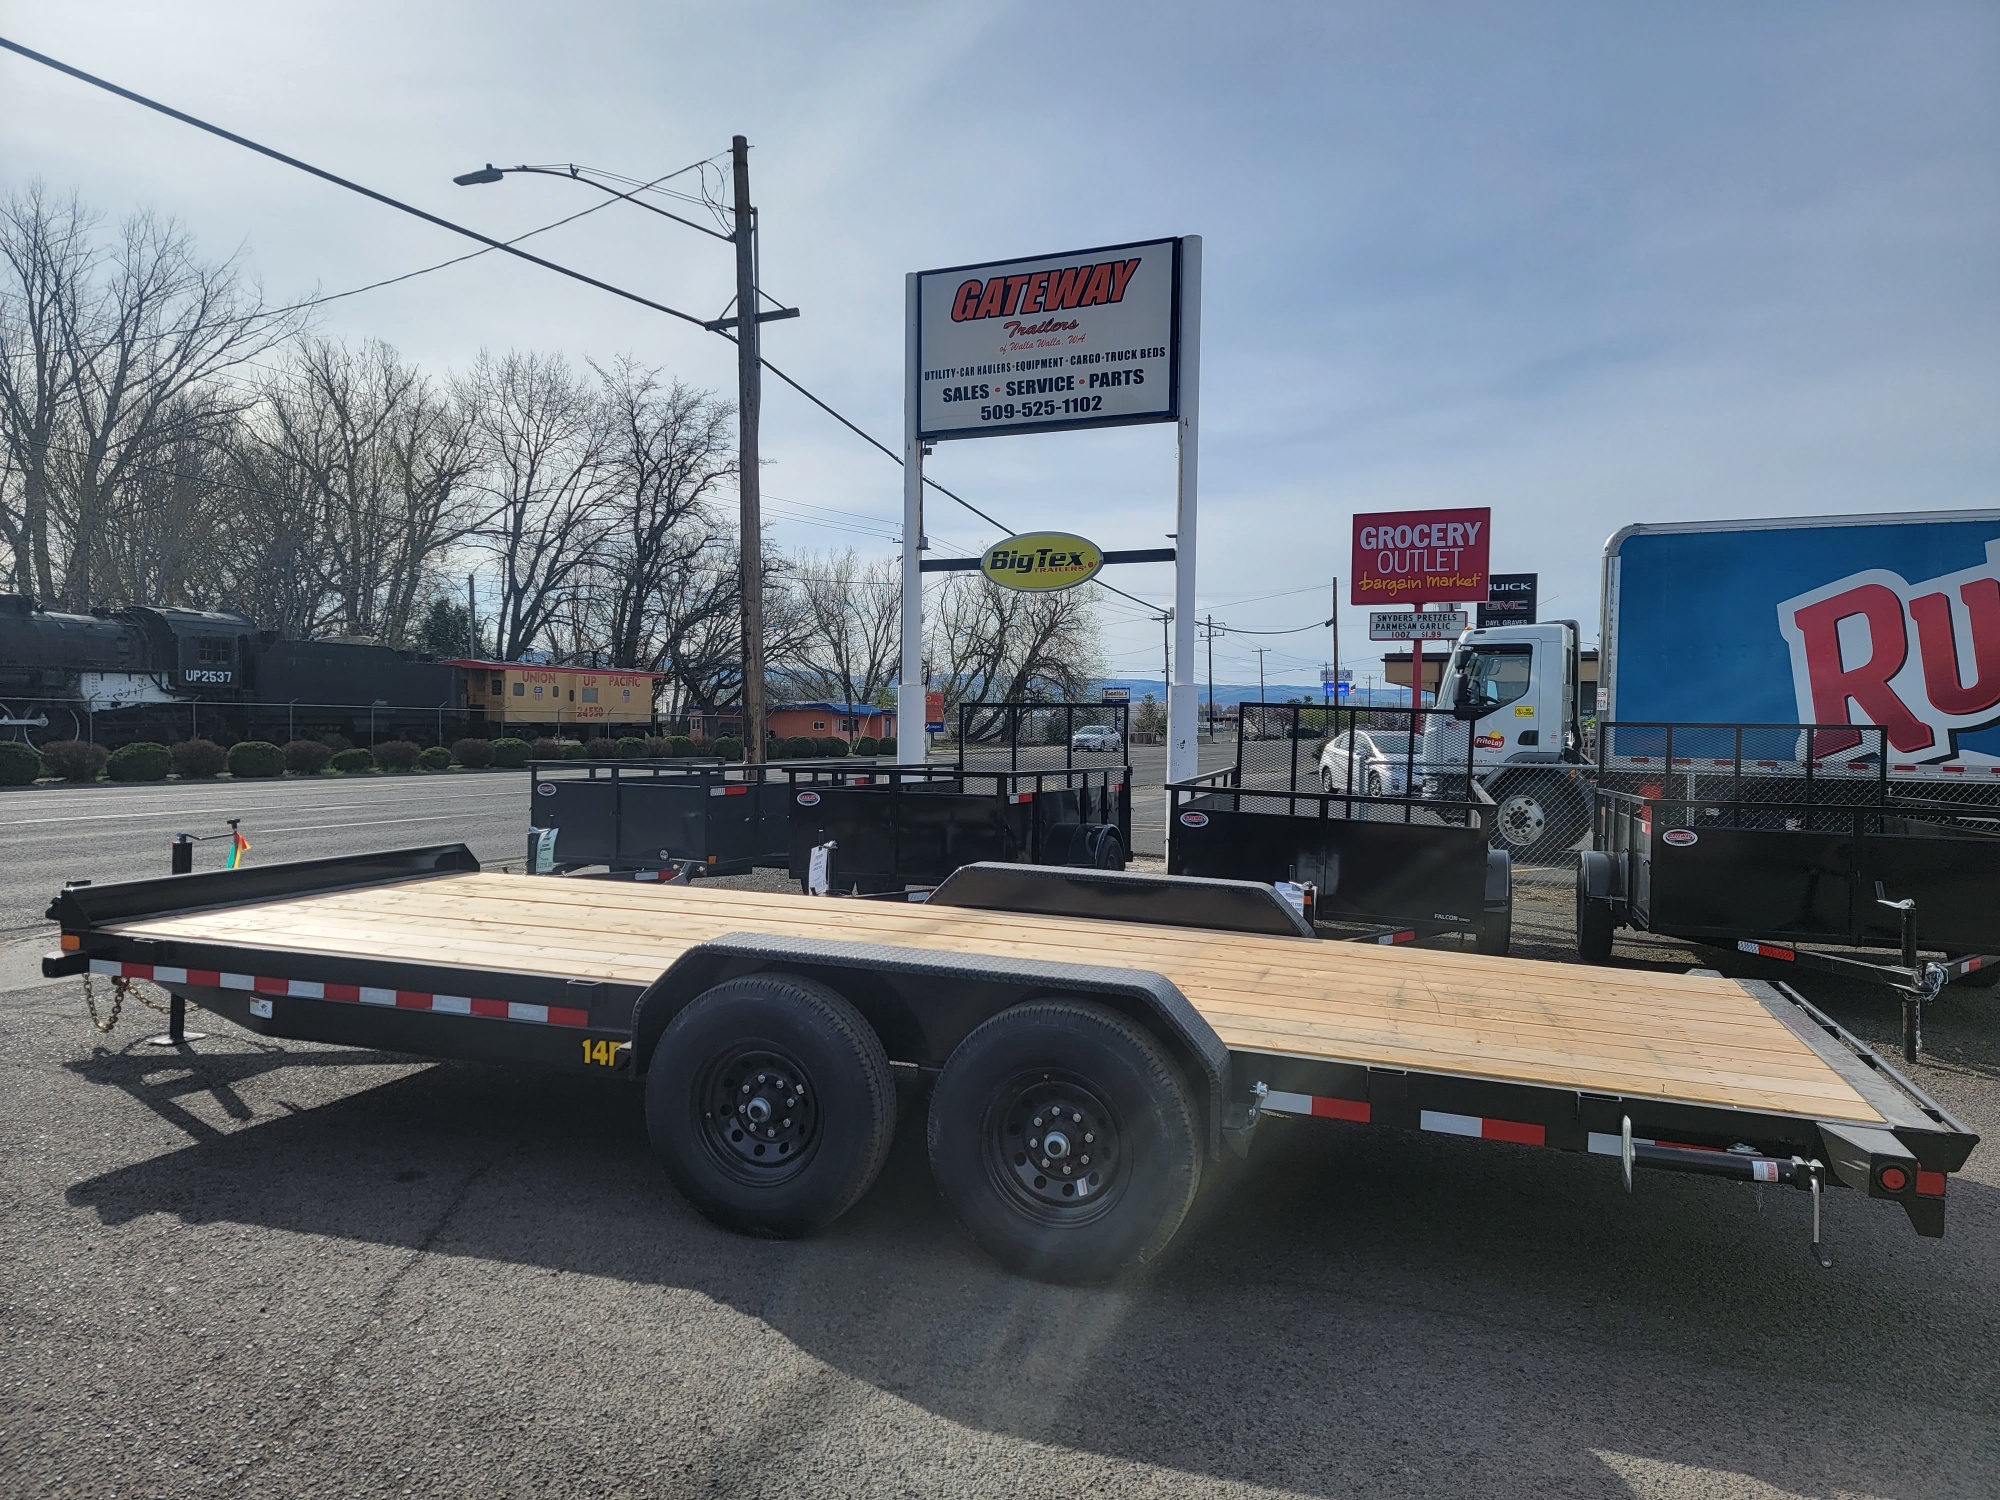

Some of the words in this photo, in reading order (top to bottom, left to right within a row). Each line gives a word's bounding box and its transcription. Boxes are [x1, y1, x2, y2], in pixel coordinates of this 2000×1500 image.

[951, 258, 1142, 323] GATEWAY
[1003, 317, 1079, 338] Trailers
[999, 344, 1007, 354] of
[1010, 341, 1035, 352] Walla
[1068, 333, 1087, 345] WA
[924, 368, 956, 381] UTILITY
[960, 366, 975, 377] CAR
[977, 362, 1011, 376] HAULERS
[1015, 357, 1064, 372] EQUIPMENT
[1070, 353, 1101, 365] CARGO
[1105, 349, 1138, 363] TRUCK
[1140, 346, 1166, 359] BEDS
[942, 384, 989, 403] SALES
[1006, 375, 1075, 397] SERVICE
[1089, 368, 1145, 389] PARTS
[981, 395, 1102, 421] 509-525-1102
[1360, 521, 1482, 550] GROCERY
[1034, 565, 1085, 573] TRAILERS
[1377, 548, 1464, 574] OUTLET
[1358, 571, 1422, 596] bargain
[1426, 572, 1480, 588] market
[1485, 600, 1528, 610] GMC
[1375, 622, 1418, 631] PARMESAN
[1420, 622, 1451, 630] GARLIC
[1377, 614, 1413, 623] SNYDERS
[1417, 613, 1457, 622] PRETZELS
[1485, 619, 1500, 627] DAYL
[1421, 631, 1442, 639] $1.99
[185, 669, 232, 683] UP2537
[522, 671, 556, 684] UNION
[583, 676, 597, 687] UP
[608, 676, 641, 688] PACIFIC
[1434, 913, 1458, 921] FALCON
